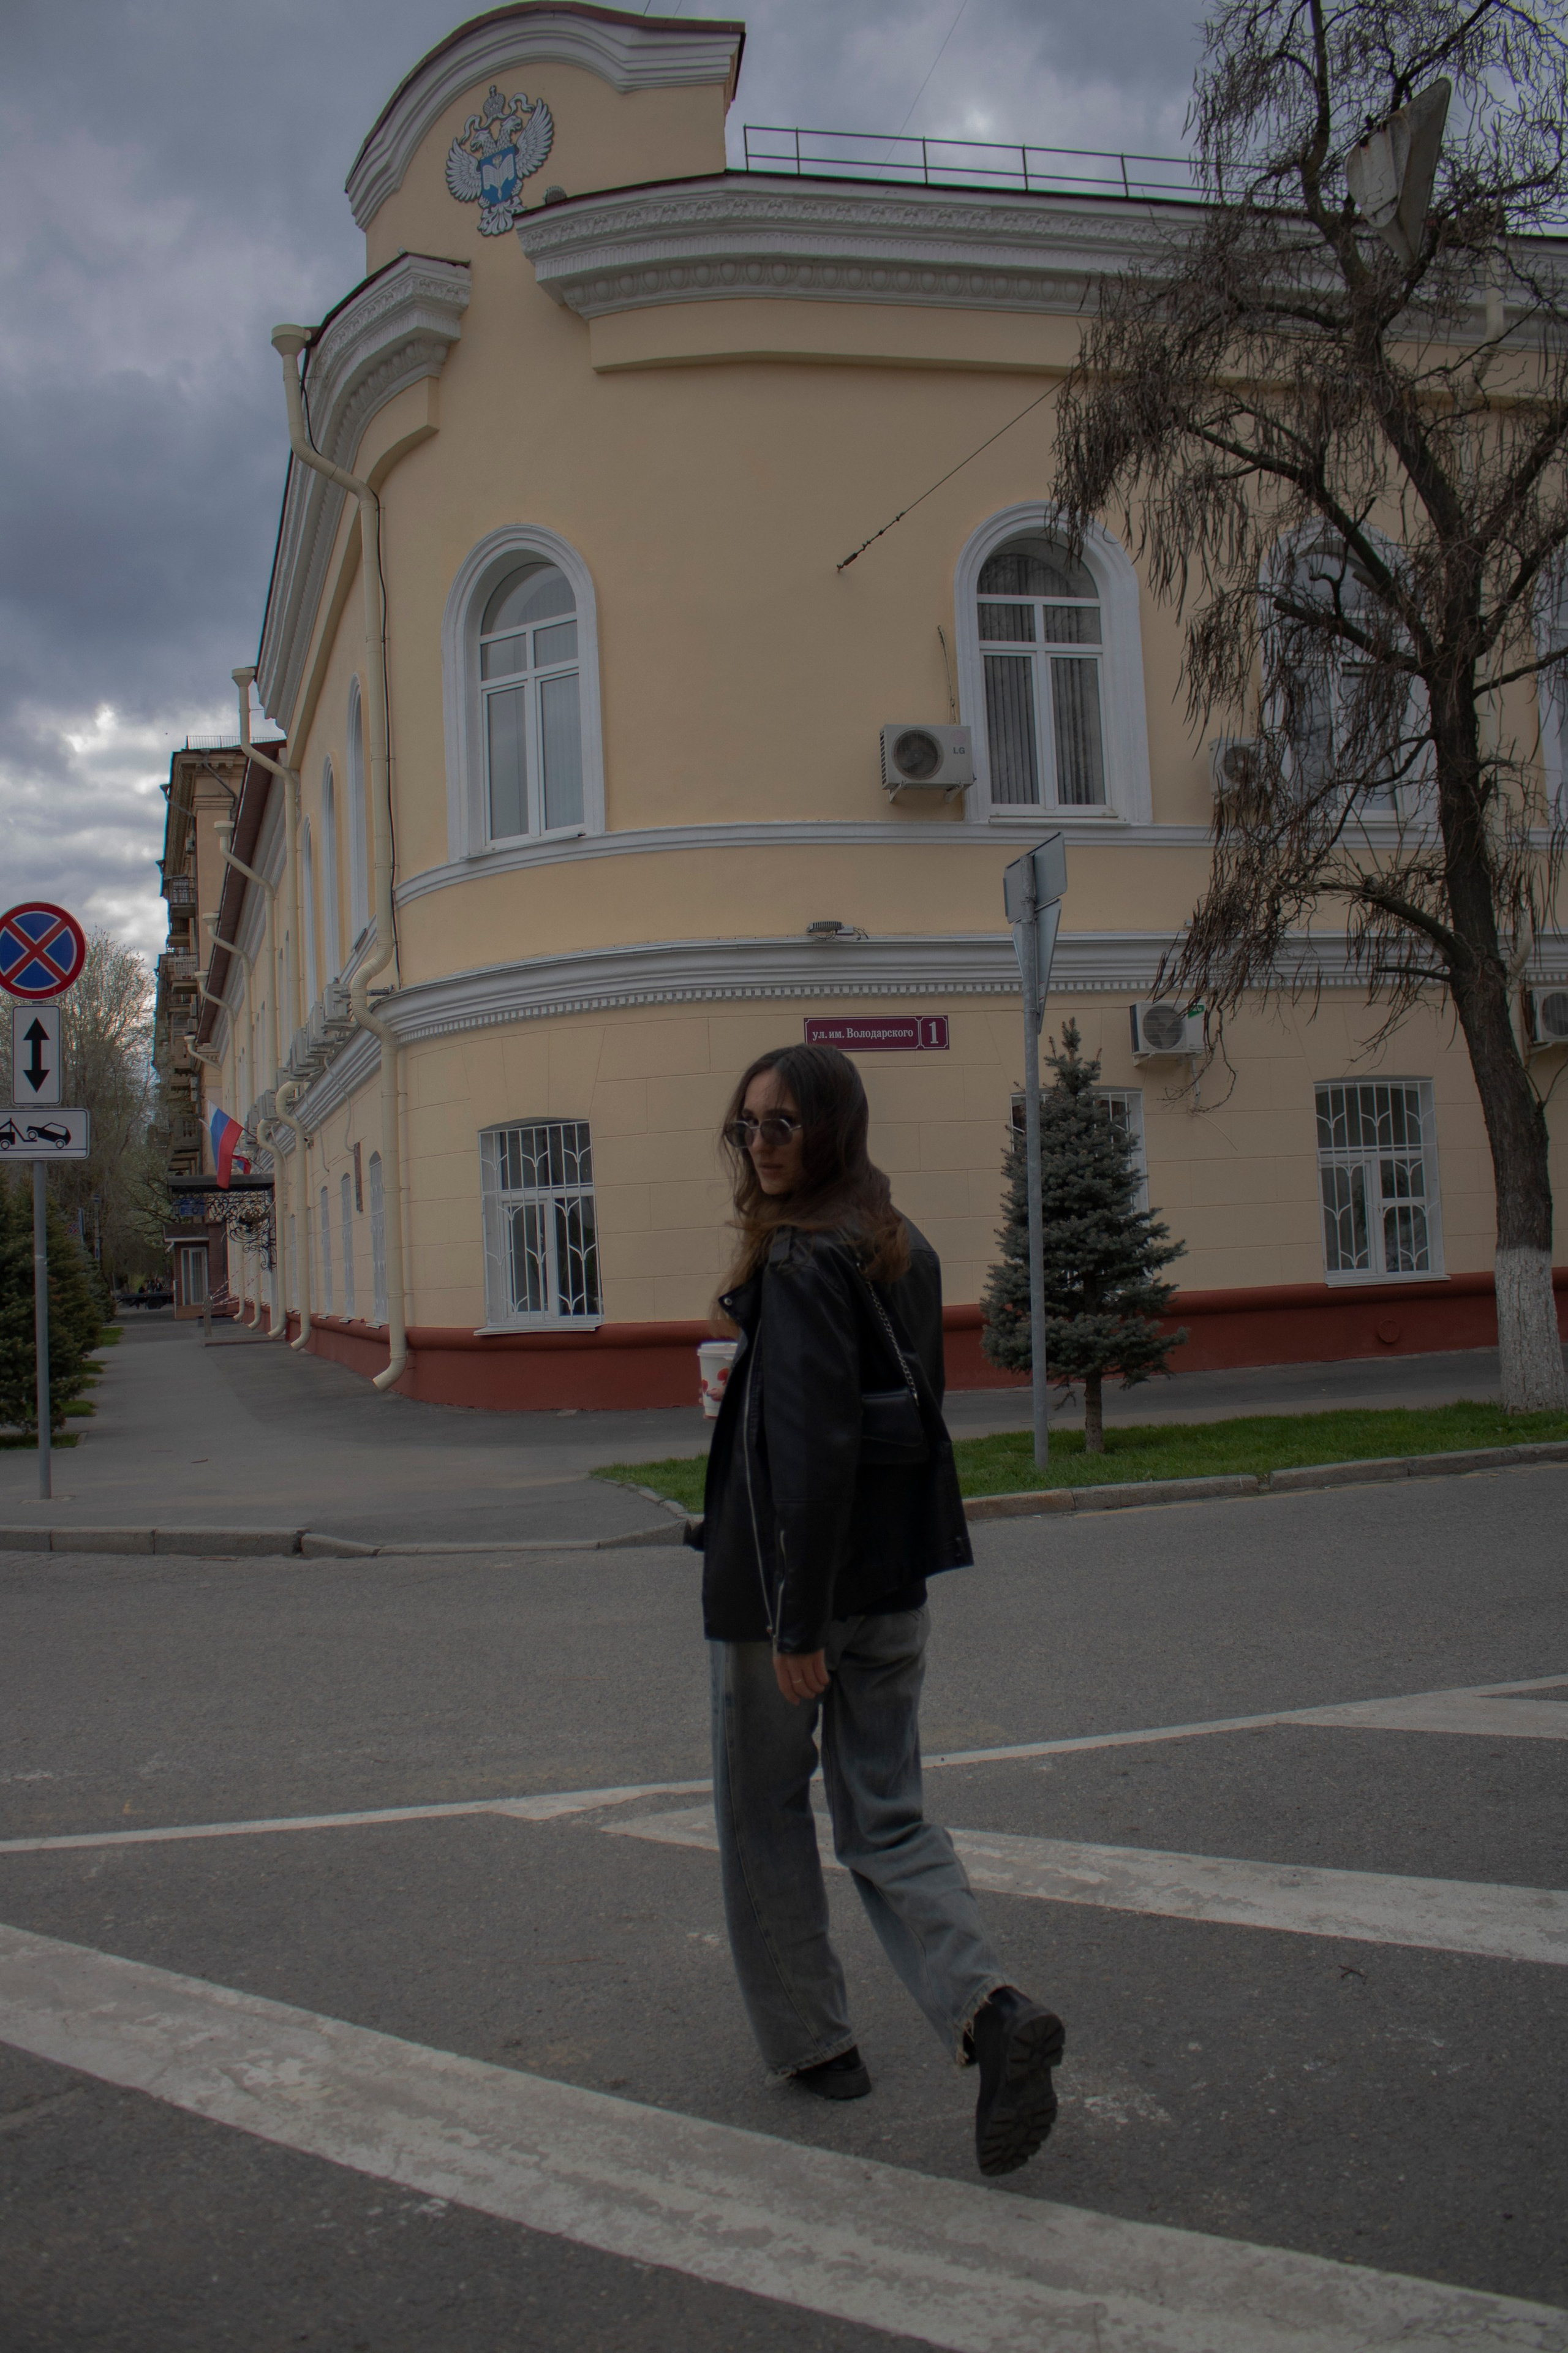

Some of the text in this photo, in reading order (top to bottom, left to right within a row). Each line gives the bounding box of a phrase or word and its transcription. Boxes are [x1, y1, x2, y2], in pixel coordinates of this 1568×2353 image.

[812, 1031, 827, 1041] ул.
[846, 1027, 914, 1040] Володарского
[929, 1021, 939, 1044] 1
